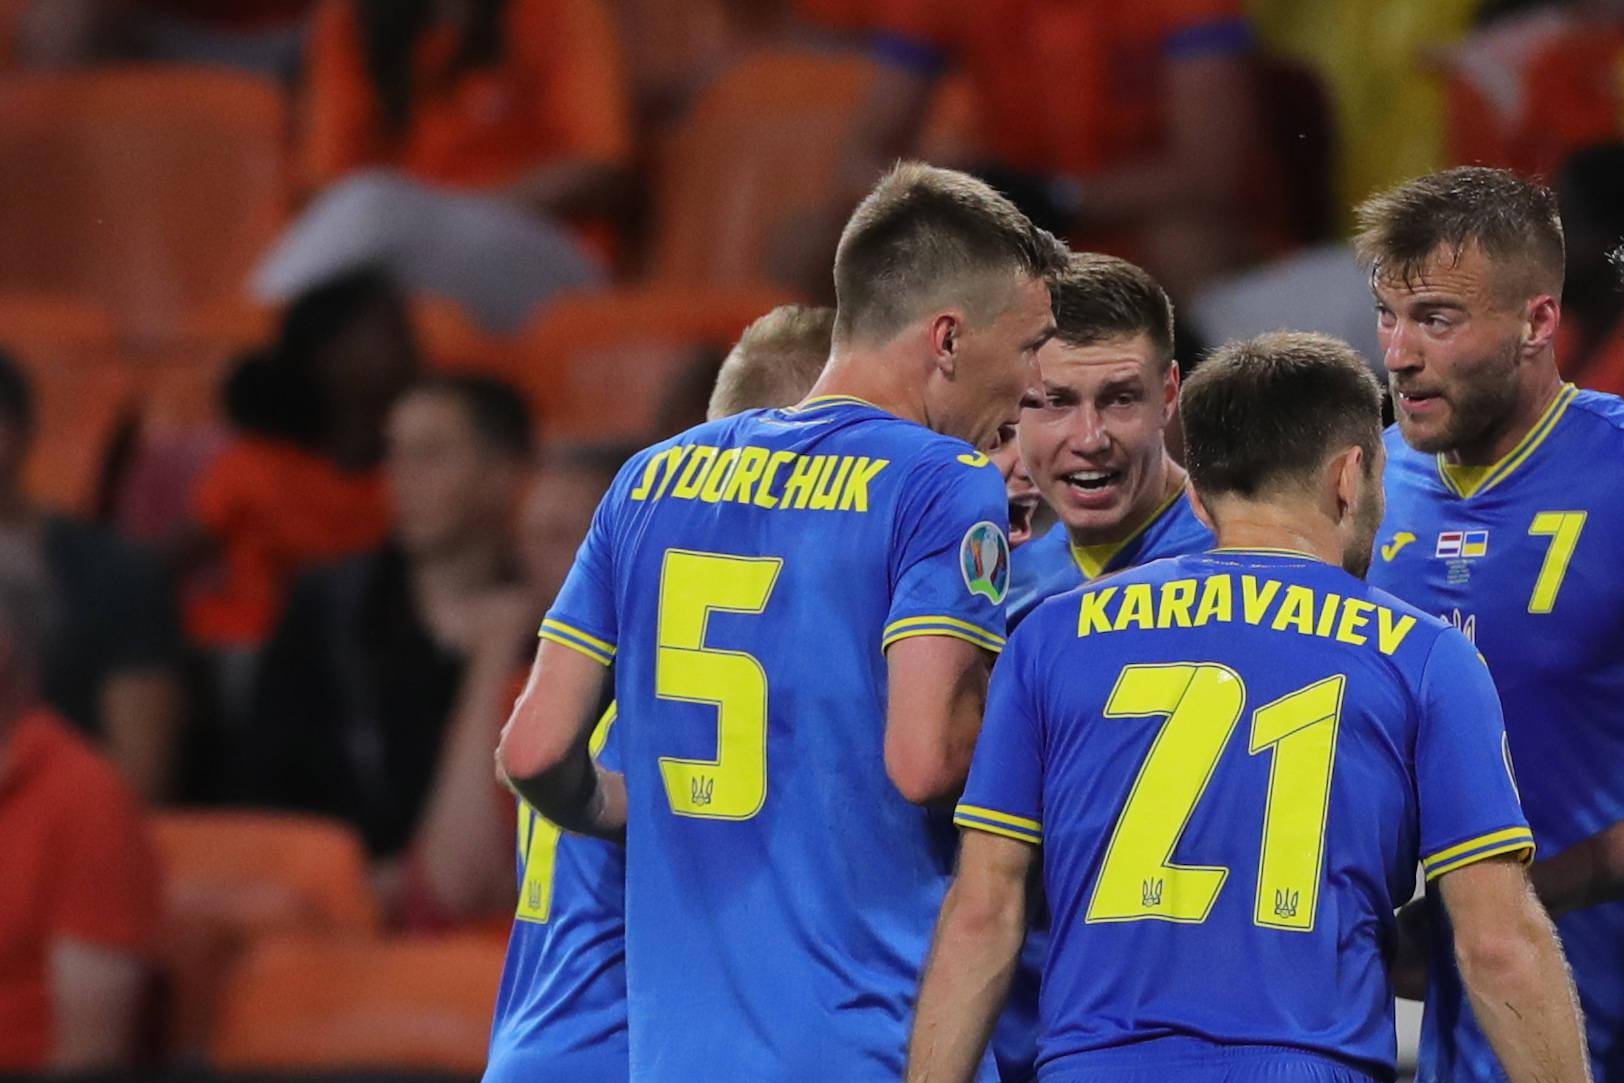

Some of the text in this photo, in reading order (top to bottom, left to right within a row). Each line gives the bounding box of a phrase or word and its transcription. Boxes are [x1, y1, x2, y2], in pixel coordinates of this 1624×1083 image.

[631, 444, 891, 513] SYDORCHUK
[1528, 510, 1588, 614] 7
[1077, 573, 1417, 657] KARAVAIEV
[655, 548, 784, 821] 5
[1085, 661, 1347, 933] 21
